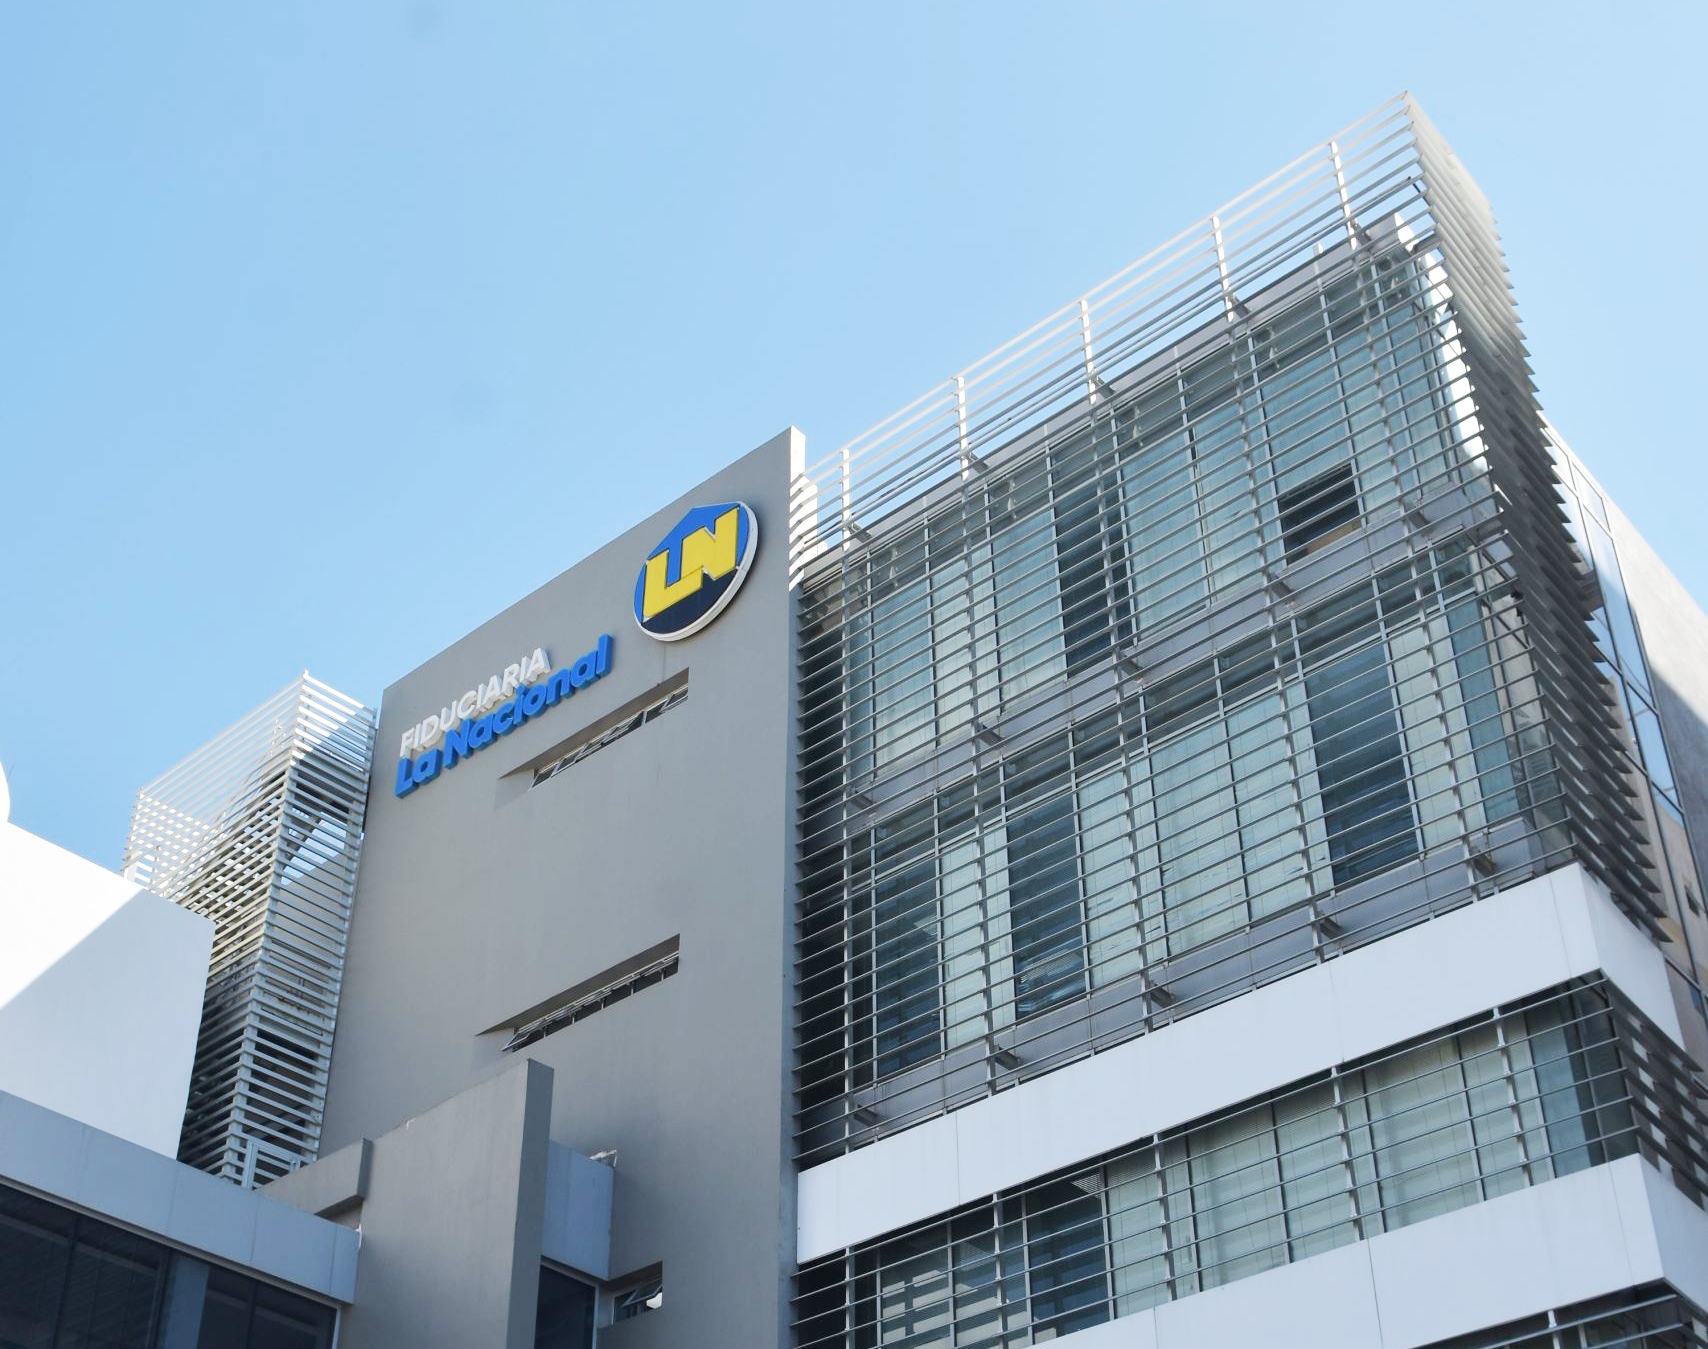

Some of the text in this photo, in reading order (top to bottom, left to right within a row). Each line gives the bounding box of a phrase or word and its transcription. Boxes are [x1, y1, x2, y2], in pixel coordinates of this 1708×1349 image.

[643, 504, 739, 622] LN
[395, 634, 614, 798] La Nacional
[400, 648, 551, 757] FIDUCIARIA
